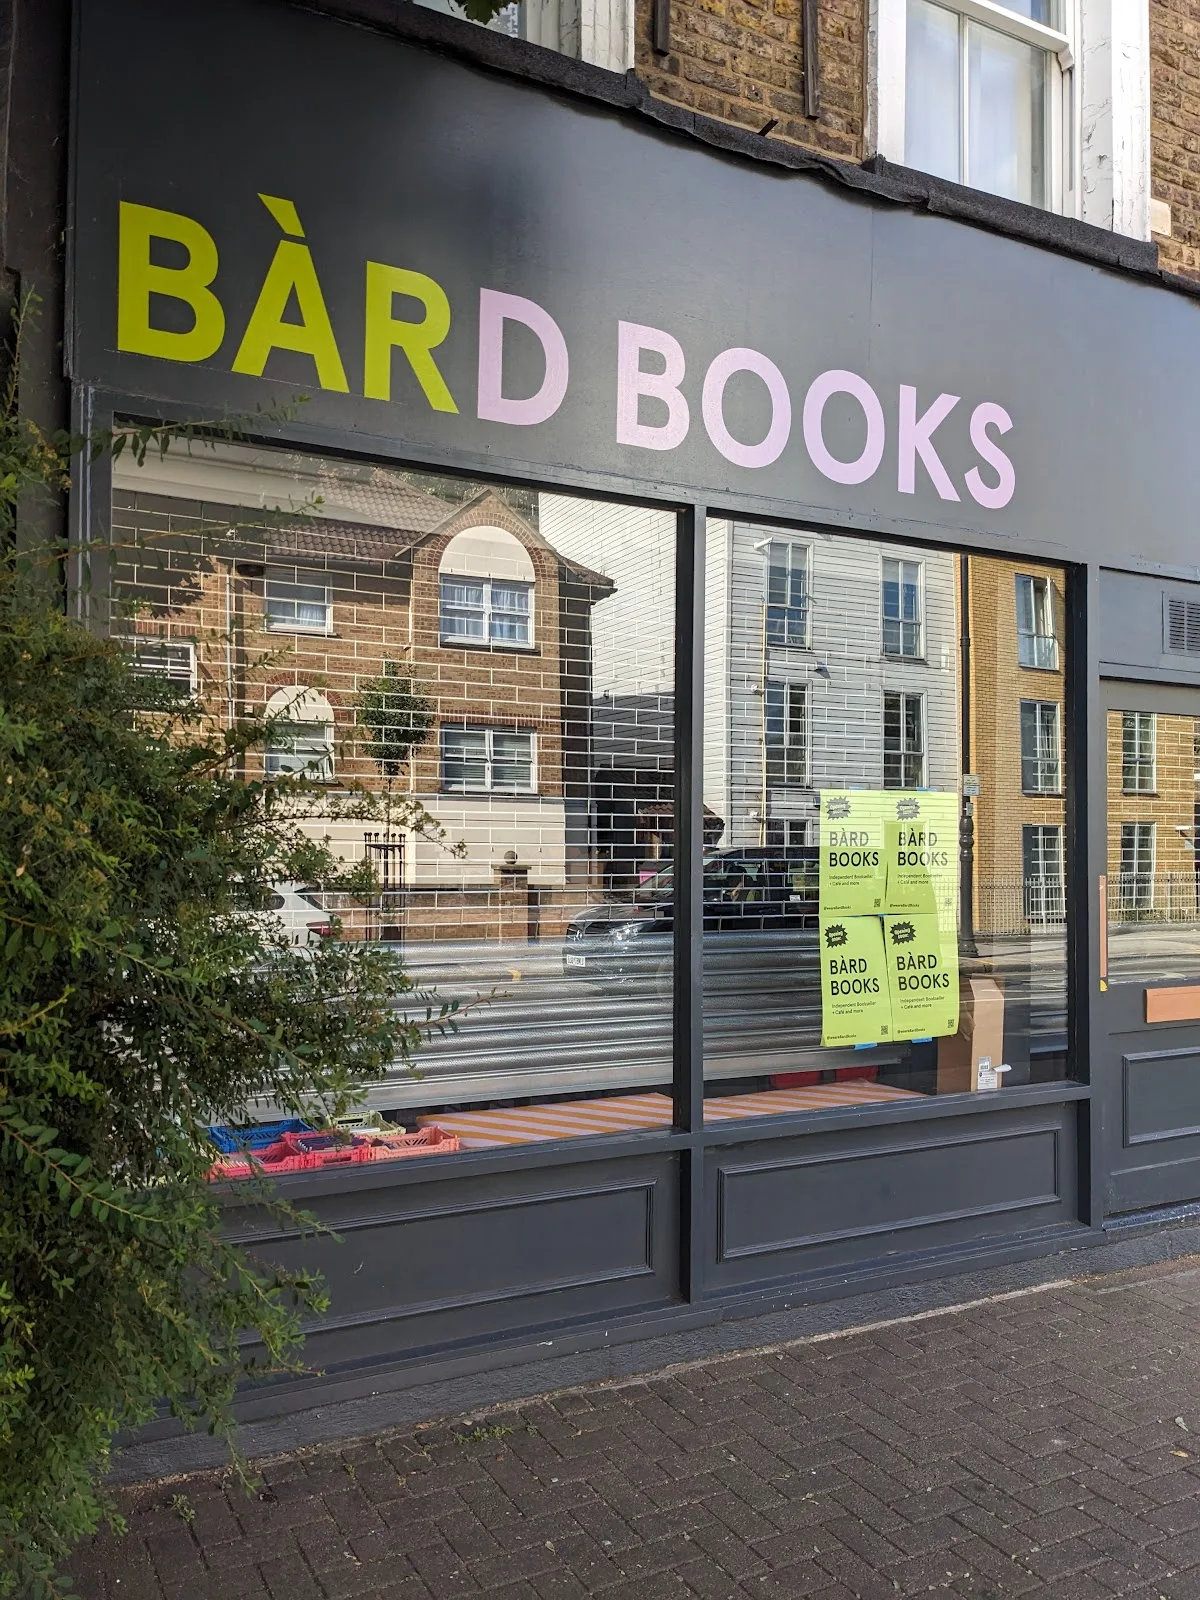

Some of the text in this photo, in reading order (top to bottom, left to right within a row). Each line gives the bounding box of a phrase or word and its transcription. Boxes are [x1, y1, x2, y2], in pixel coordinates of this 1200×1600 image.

[117, 192, 1016, 509] BÀRD BOOKS
[829, 828, 869, 847] BÀRD
[898, 828, 938, 846] BÀRD
[829, 852, 879, 867] BOOKS
[898, 852, 948, 866] BOOKS
[830, 955, 867, 975] BÀRD
[896, 952, 938, 971] BÀRD
[831, 977, 880, 996] BOOKS
[898, 973, 950, 991] BOOKS
